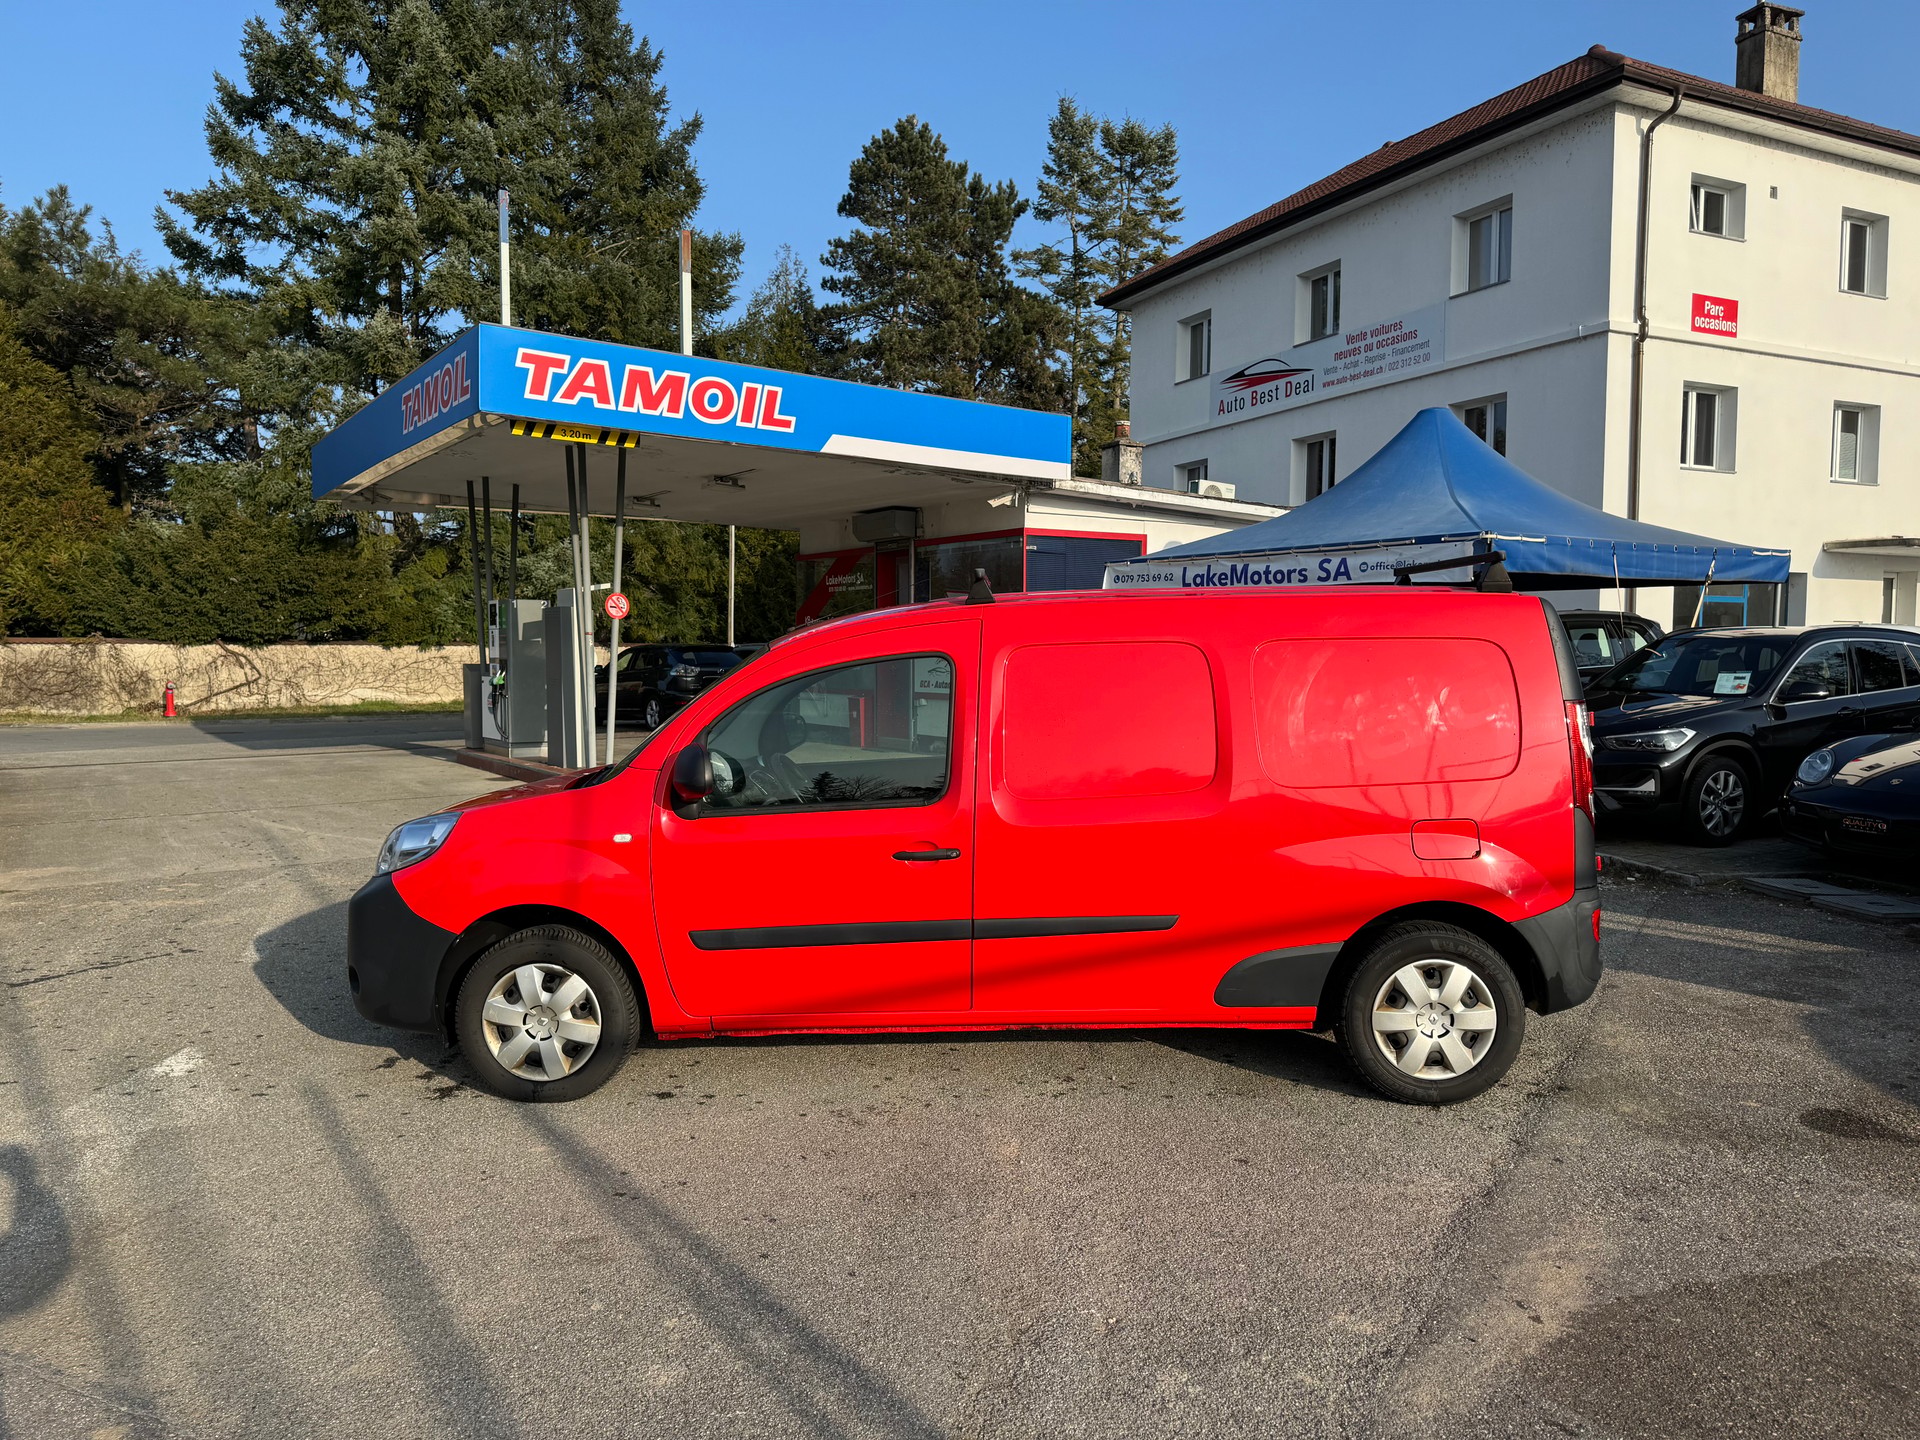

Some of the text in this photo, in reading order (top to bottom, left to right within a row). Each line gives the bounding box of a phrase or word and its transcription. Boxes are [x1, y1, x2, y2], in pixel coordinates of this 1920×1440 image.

[1694, 316, 1737, 333] occasions
[1704, 301, 1724, 317] Parc
[1334, 329, 1418, 362] neuves ou occasions
[1346, 320, 1403, 346] Vente voitures
[1322, 366, 1384, 388] www.auto-best-deal.ch
[1388, 360, 1401, 372] 022
[1400, 356, 1413, 369] 312
[1413, 354, 1423, 365] 52
[1422, 352, 1431, 362] 00
[1323, 365, 1338, 376] Vente
[1343, 358, 1360, 371] Achat
[1364, 351, 1386, 366] Reprise
[1392, 339, 1430, 357] Financement
[402, 351, 471, 435] TAMOIL
[515, 347, 796, 433] TAMOIL
[1218, 374, 1315, 416] Auto Best Deal
[561, 428, 592, 440] 3.20 m
[1120, 574, 1135, 583] 079
[1136, 573, 1150, 582] 753
[1152, 573, 1162, 582] 69
[1163, 572, 1174, 581] 62
[1182, 563, 1308, 588] LakeMotors
[1317, 557, 1353, 583] SA
